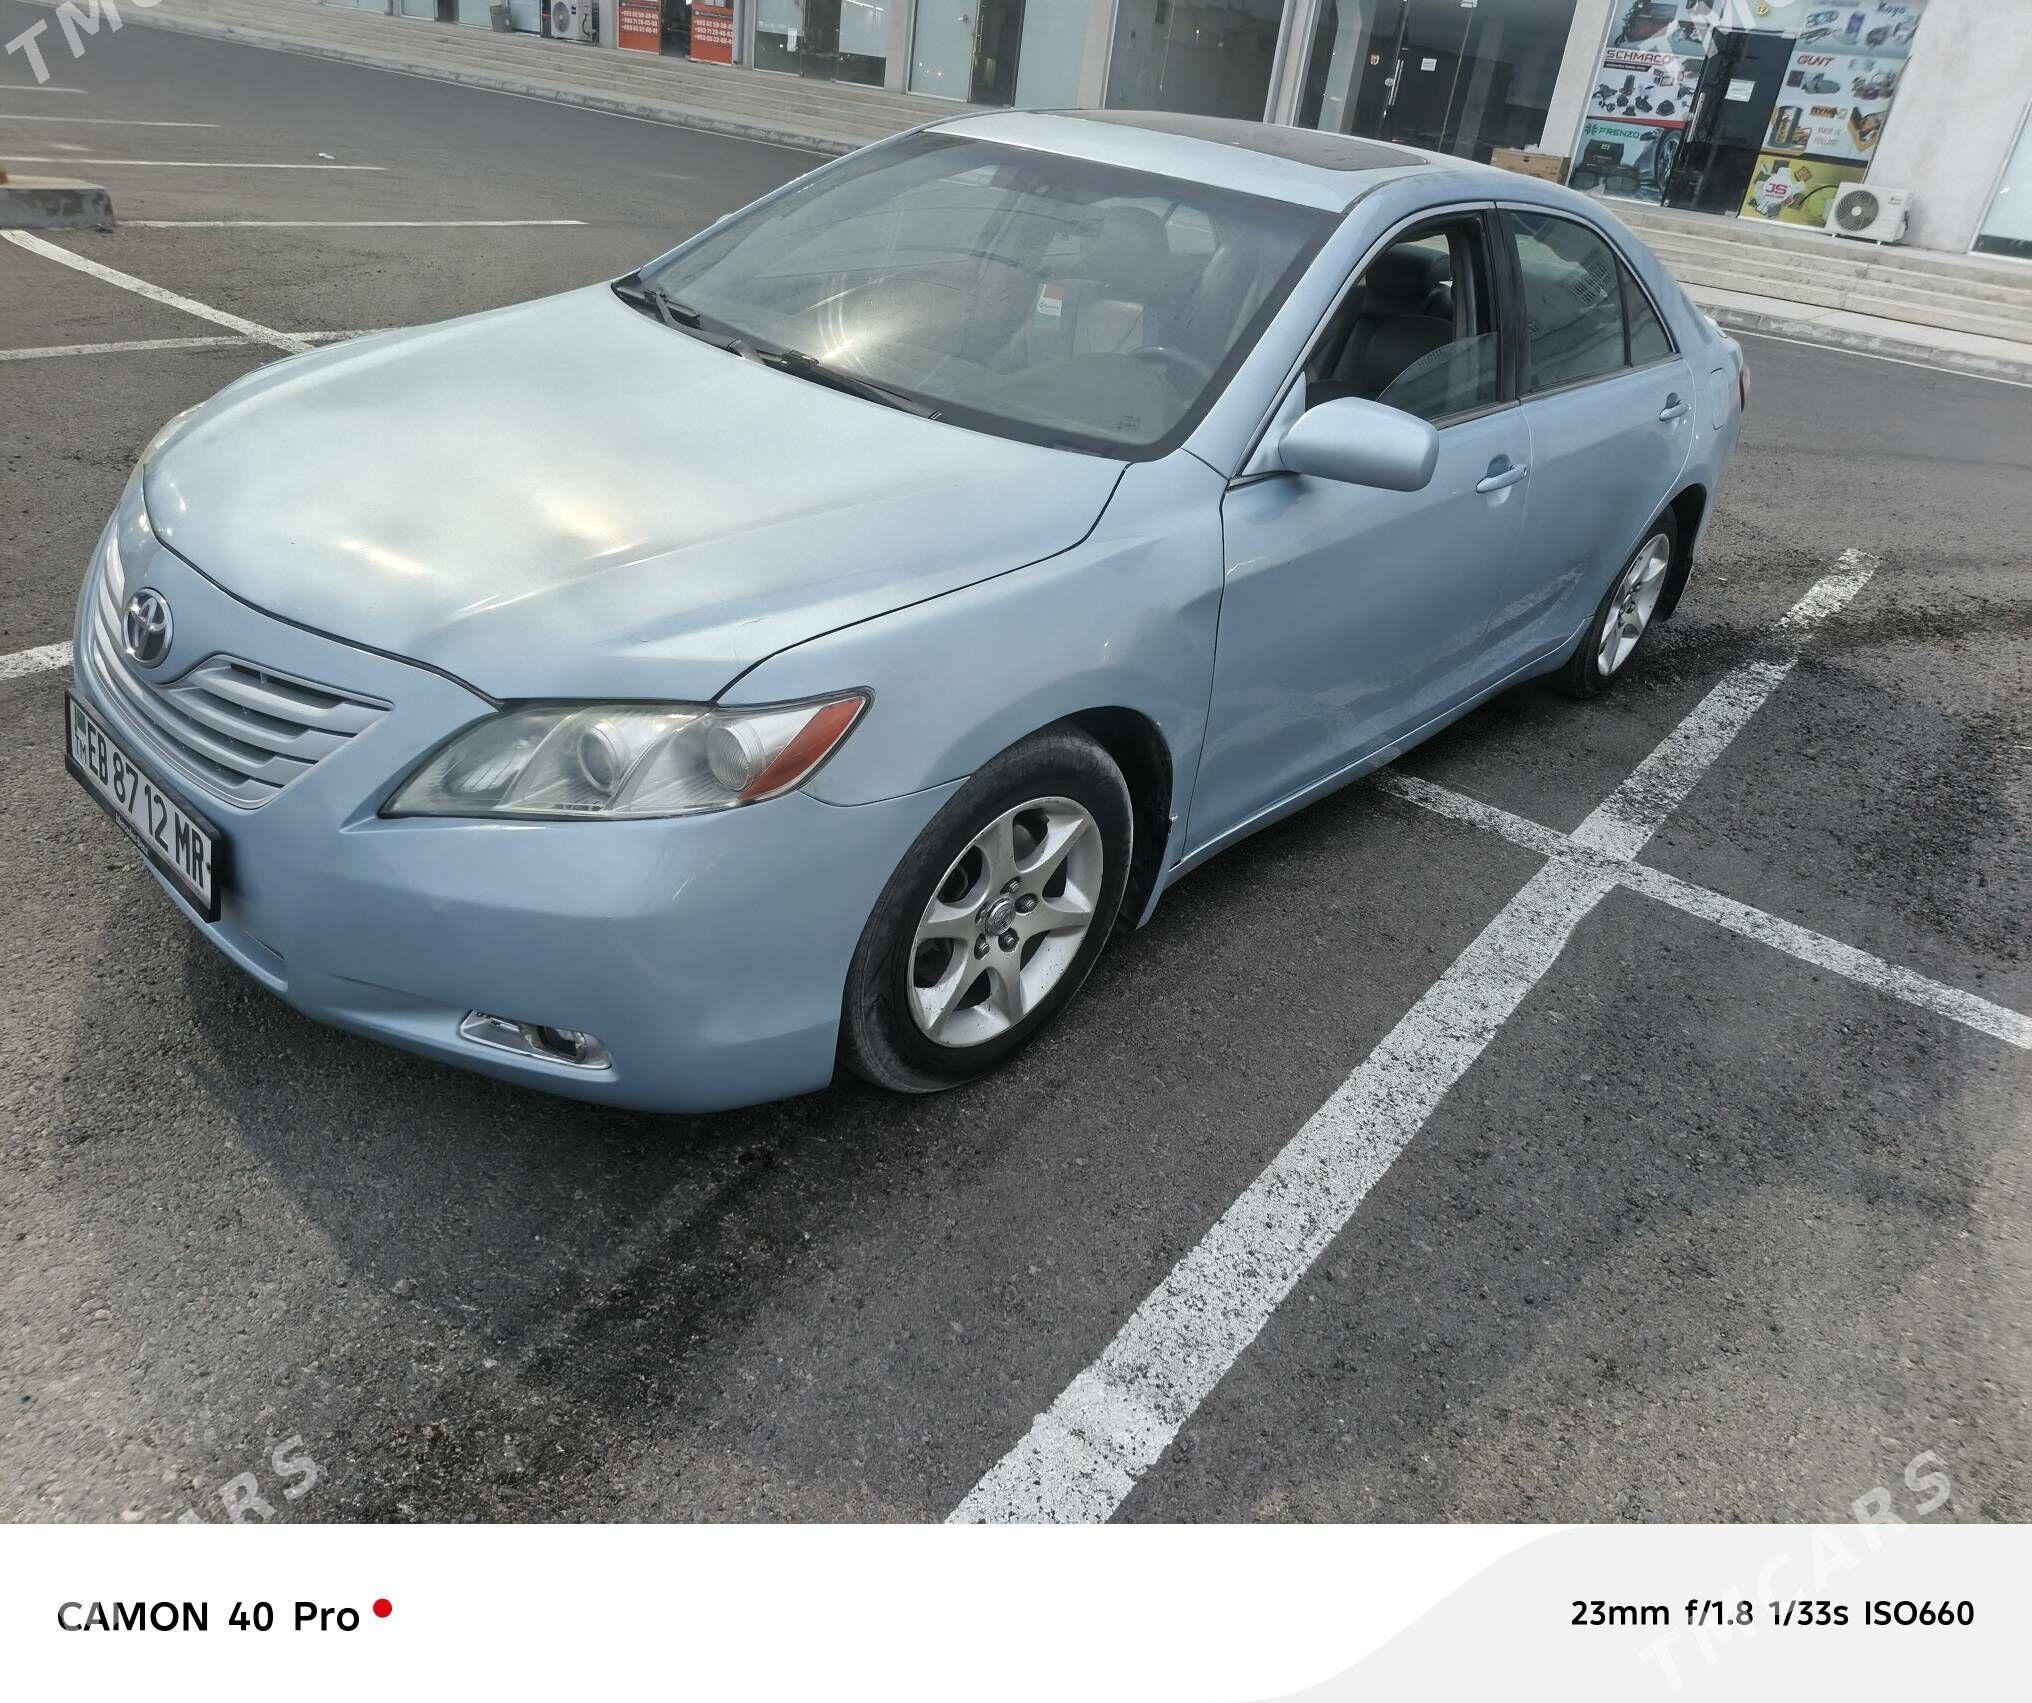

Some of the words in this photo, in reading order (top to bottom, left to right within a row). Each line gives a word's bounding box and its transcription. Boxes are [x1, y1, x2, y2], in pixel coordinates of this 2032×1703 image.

[1765, 183, 1788, 195] JS
[88, 721, 109, 786] EB
[113, 751, 139, 814] 87
[145, 783, 169, 853] 12
[175, 812, 205, 889] MR
